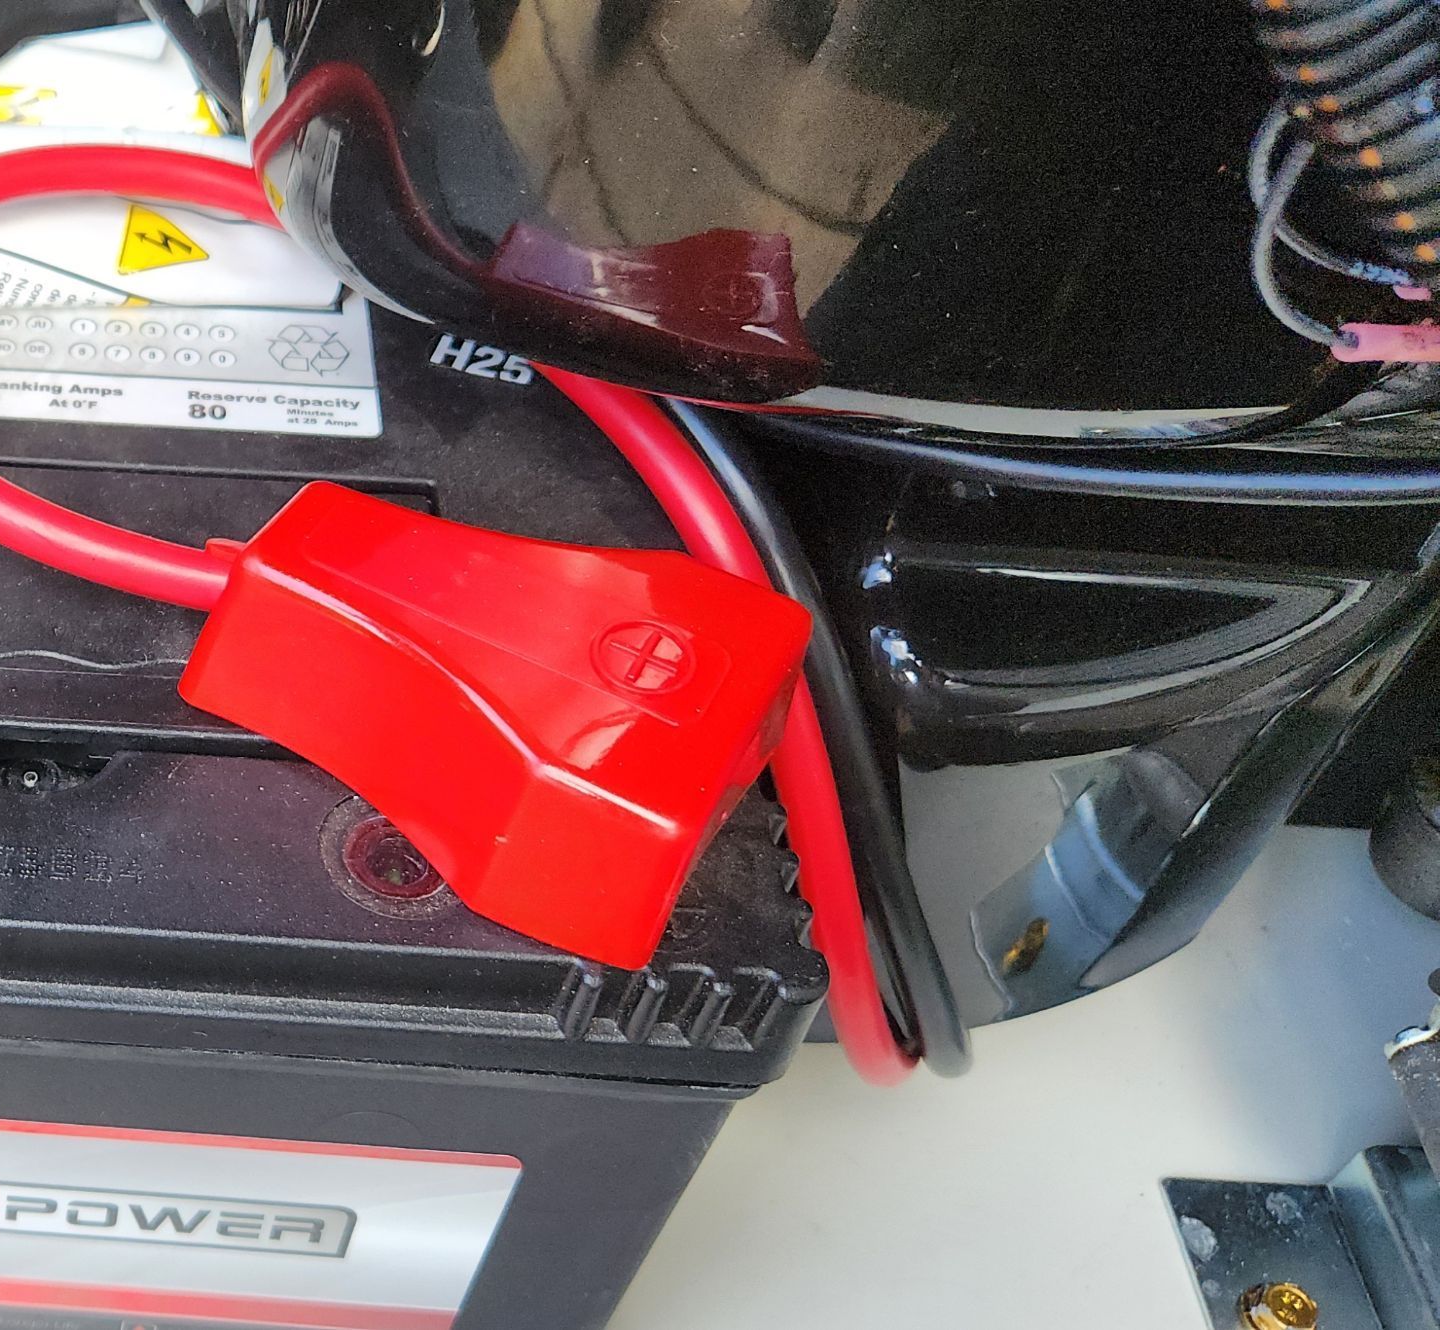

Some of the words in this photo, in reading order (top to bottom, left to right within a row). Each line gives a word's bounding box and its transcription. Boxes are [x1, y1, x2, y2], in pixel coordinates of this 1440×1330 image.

[429, 332, 534, 386] H25
[68, 383, 124, 398] Amps
[48, 398, 69, 409] At
[187, 389, 268, 405] Reserve
[272, 394, 361, 411] Capacity
[187, 403, 228, 420] 80
[286, 408, 335, 418] Minutes
[286, 416, 300, 425] at
[324, 418, 359, 429] Amps
